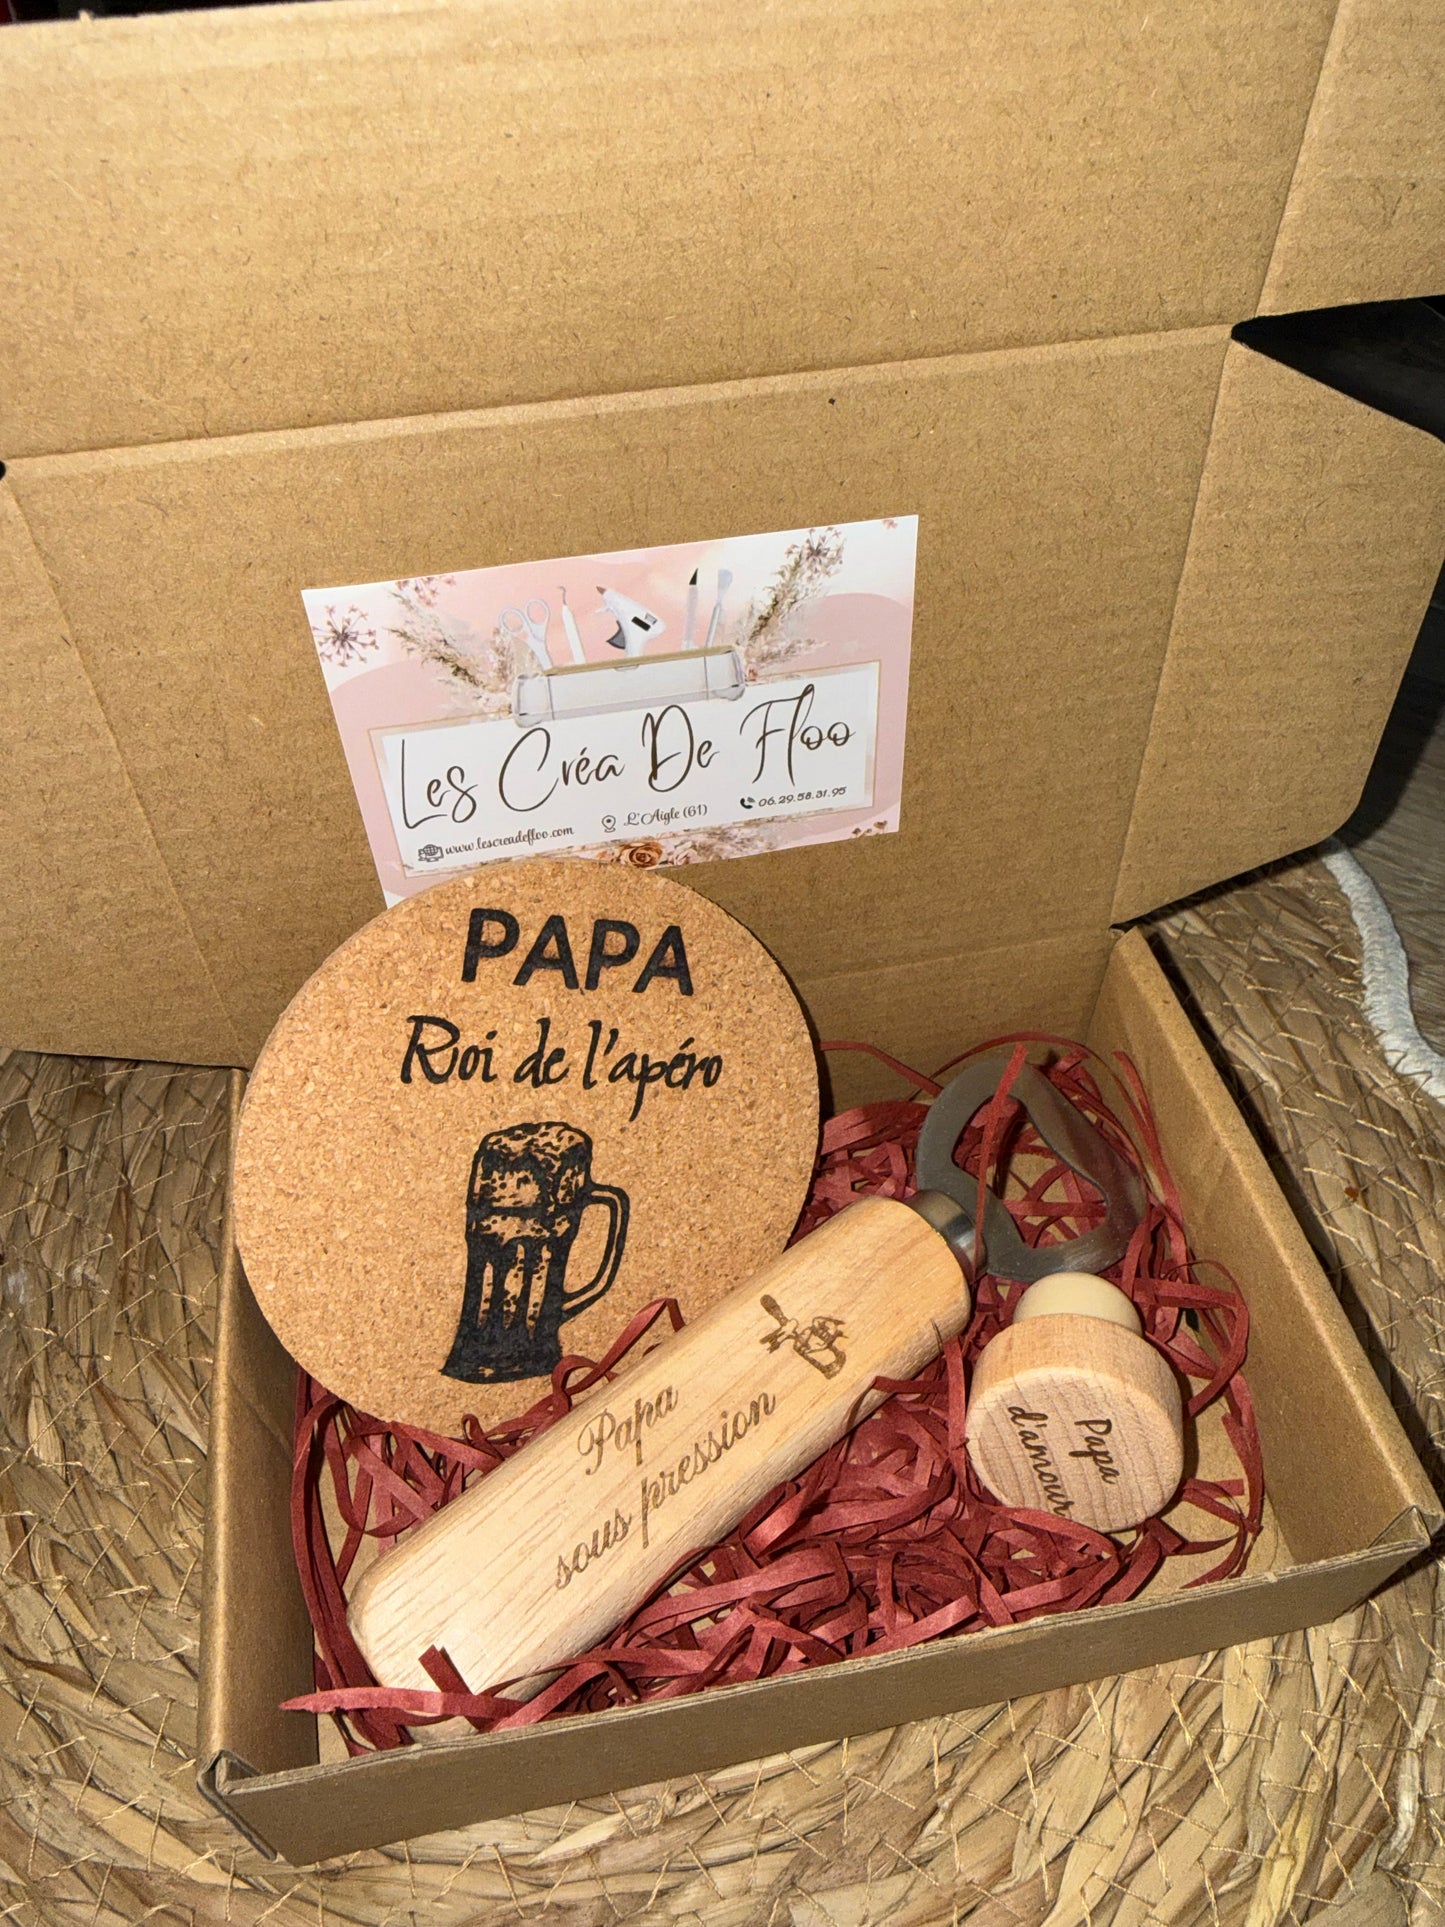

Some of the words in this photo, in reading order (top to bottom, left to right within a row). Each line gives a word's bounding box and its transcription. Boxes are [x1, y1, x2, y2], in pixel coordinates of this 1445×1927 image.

[401, 738, 478, 830] Les
[498, 727, 626, 812] Créa
[642, 704, 720, 793] De
[739, 683, 855, 785] Floo
[444, 825, 574, 854] www.lescreadefloo.com
[684, 803, 708, 820] (61)
[460, 908, 694, 996] PAPA
[400, 1015, 499, 1084] Roi
[513, 1017, 568, 1089] de
[583, 1019, 723, 1122] l'apéro
[577, 1385, 679, 1476] Papa
[1007, 1406, 1075, 1516] d'amour
[1068, 1418, 1121, 1485] Papa
[554, 1508, 632, 1590] sous
[640, 1391, 776, 1550] pression
